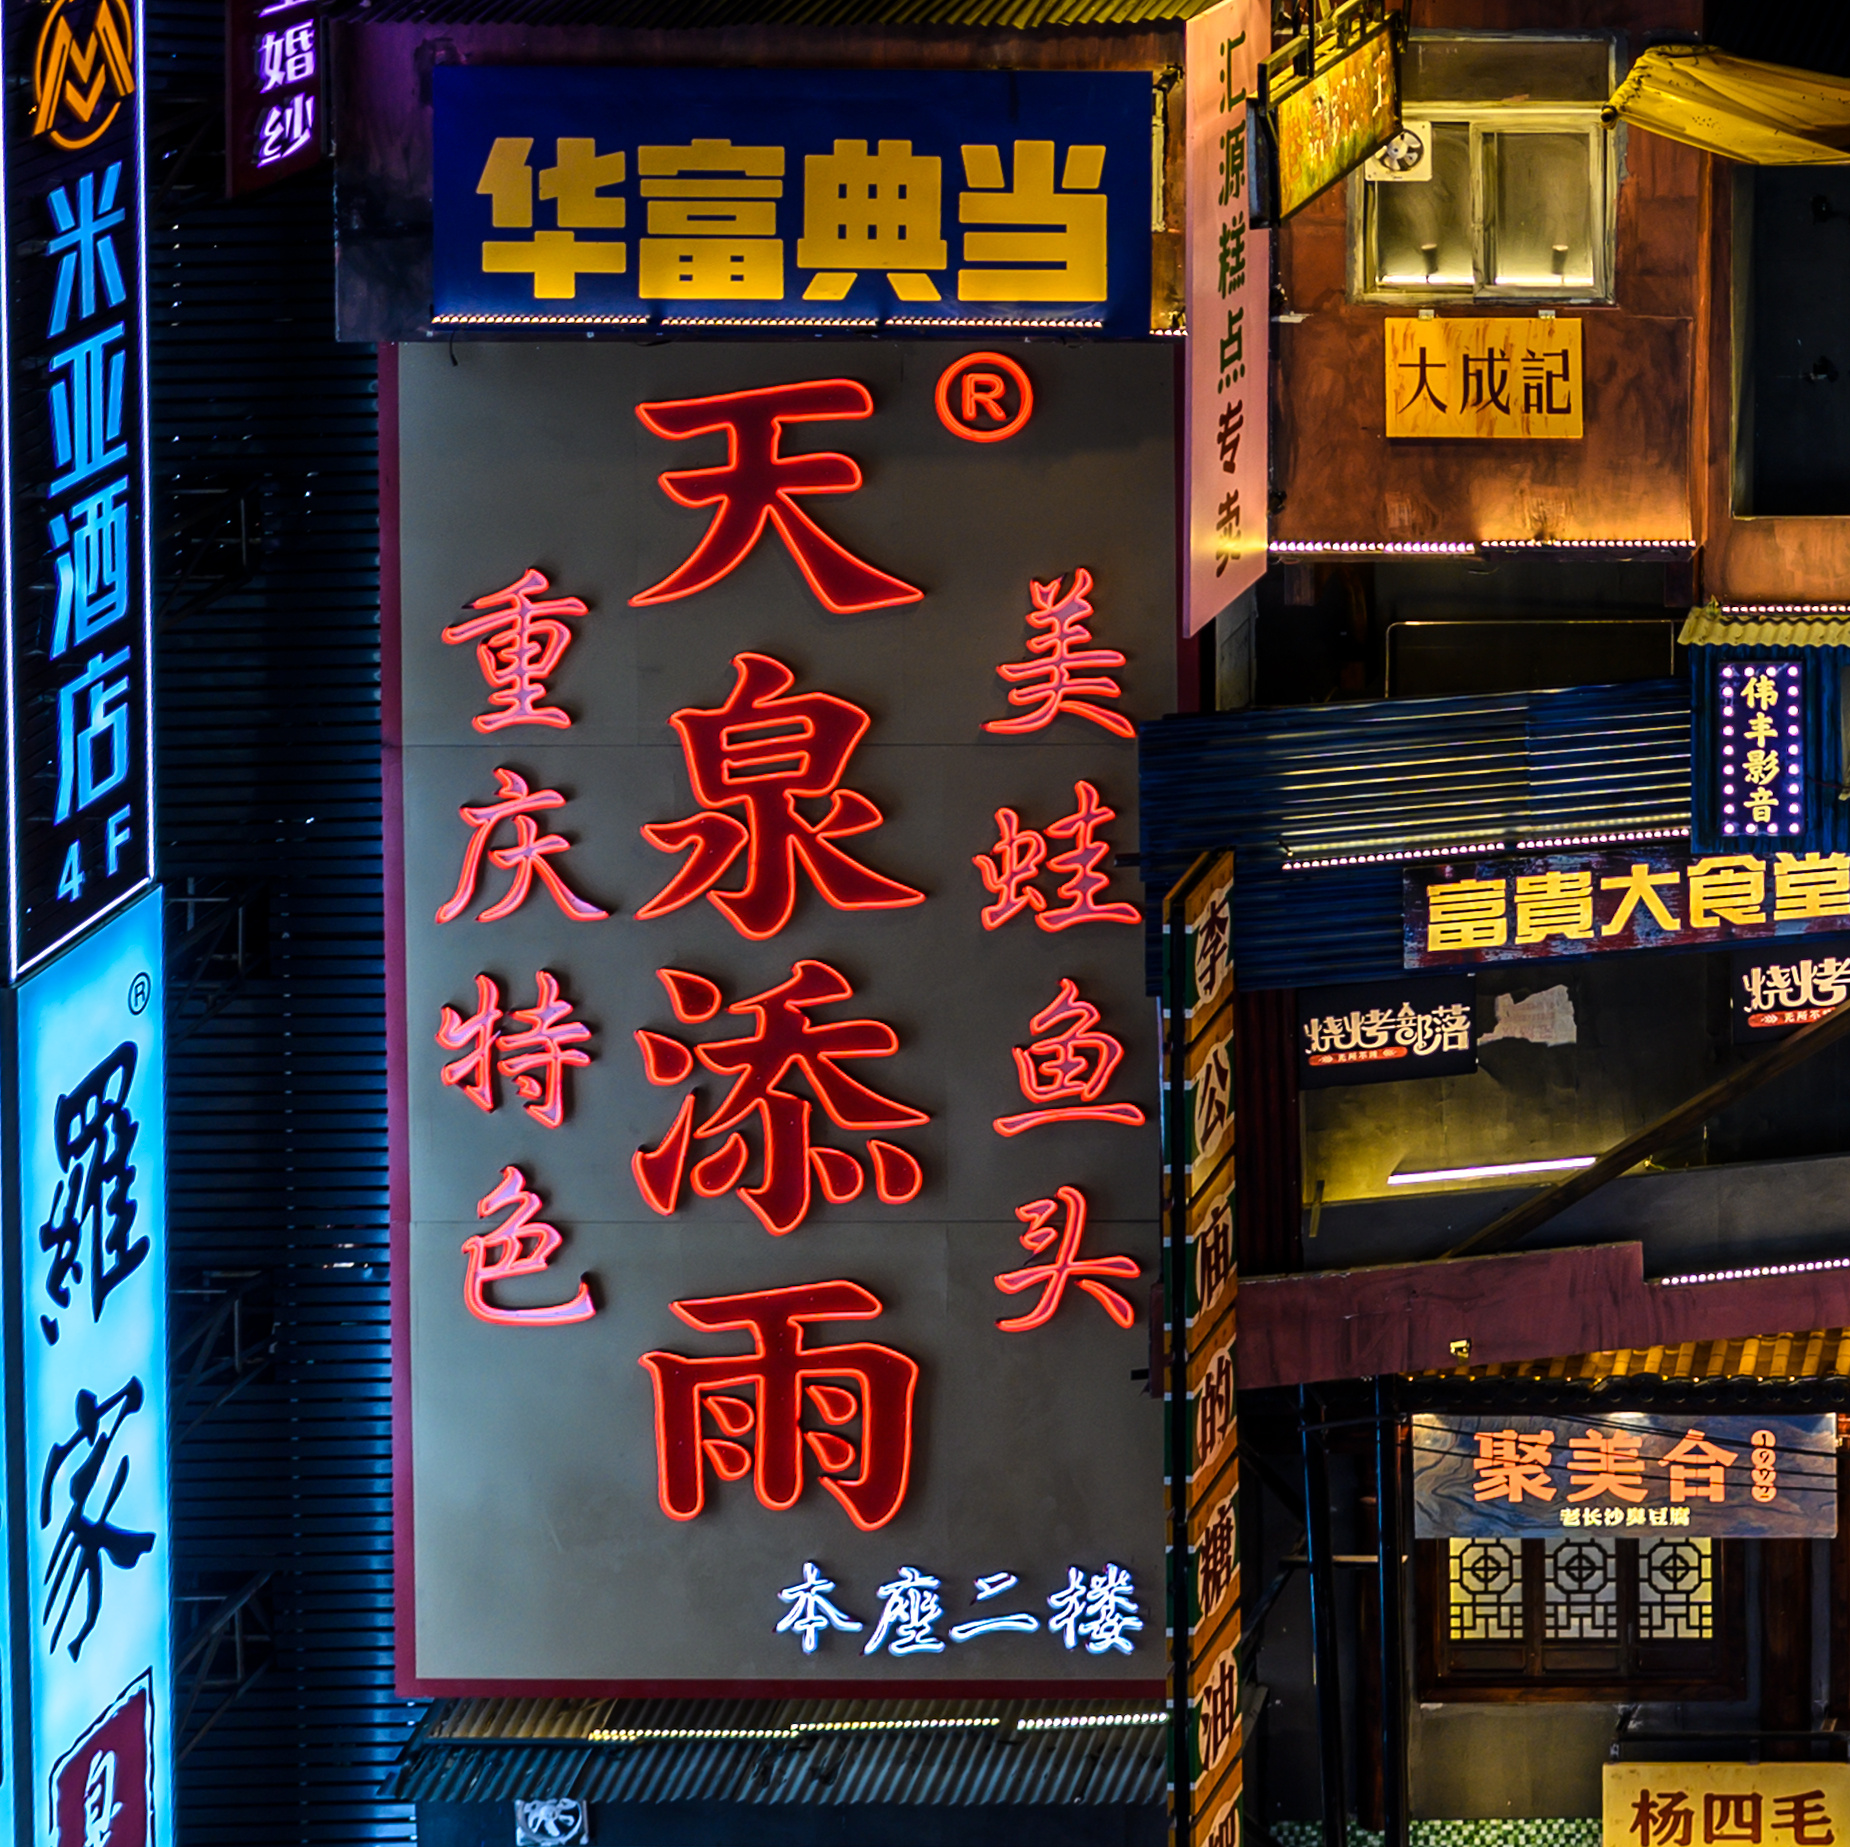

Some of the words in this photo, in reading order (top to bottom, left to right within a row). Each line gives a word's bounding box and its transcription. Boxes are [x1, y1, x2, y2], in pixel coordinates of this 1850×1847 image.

[477, 137, 1107, 302] 华富典当
[1398, 347, 1572, 414] 大成記
[46, 162, 131, 826] 米亚酒店
[1744, 675, 1780, 825] 伟丰影音
[435, 568, 609, 1325] 重庆特色
[629, 378, 930, 1531] 天泉添雨
[972, 567, 1145, 1332] 美蛙鱼头
[1304, 1002, 1473, 1056] 烧烤部落
[1472, 1428, 1739, 1503] 聚美合
[1559, 1505, 1691, 1528] 老长沙臭豆腐
[776, 1561, 1143, 1655] 本座二楼
